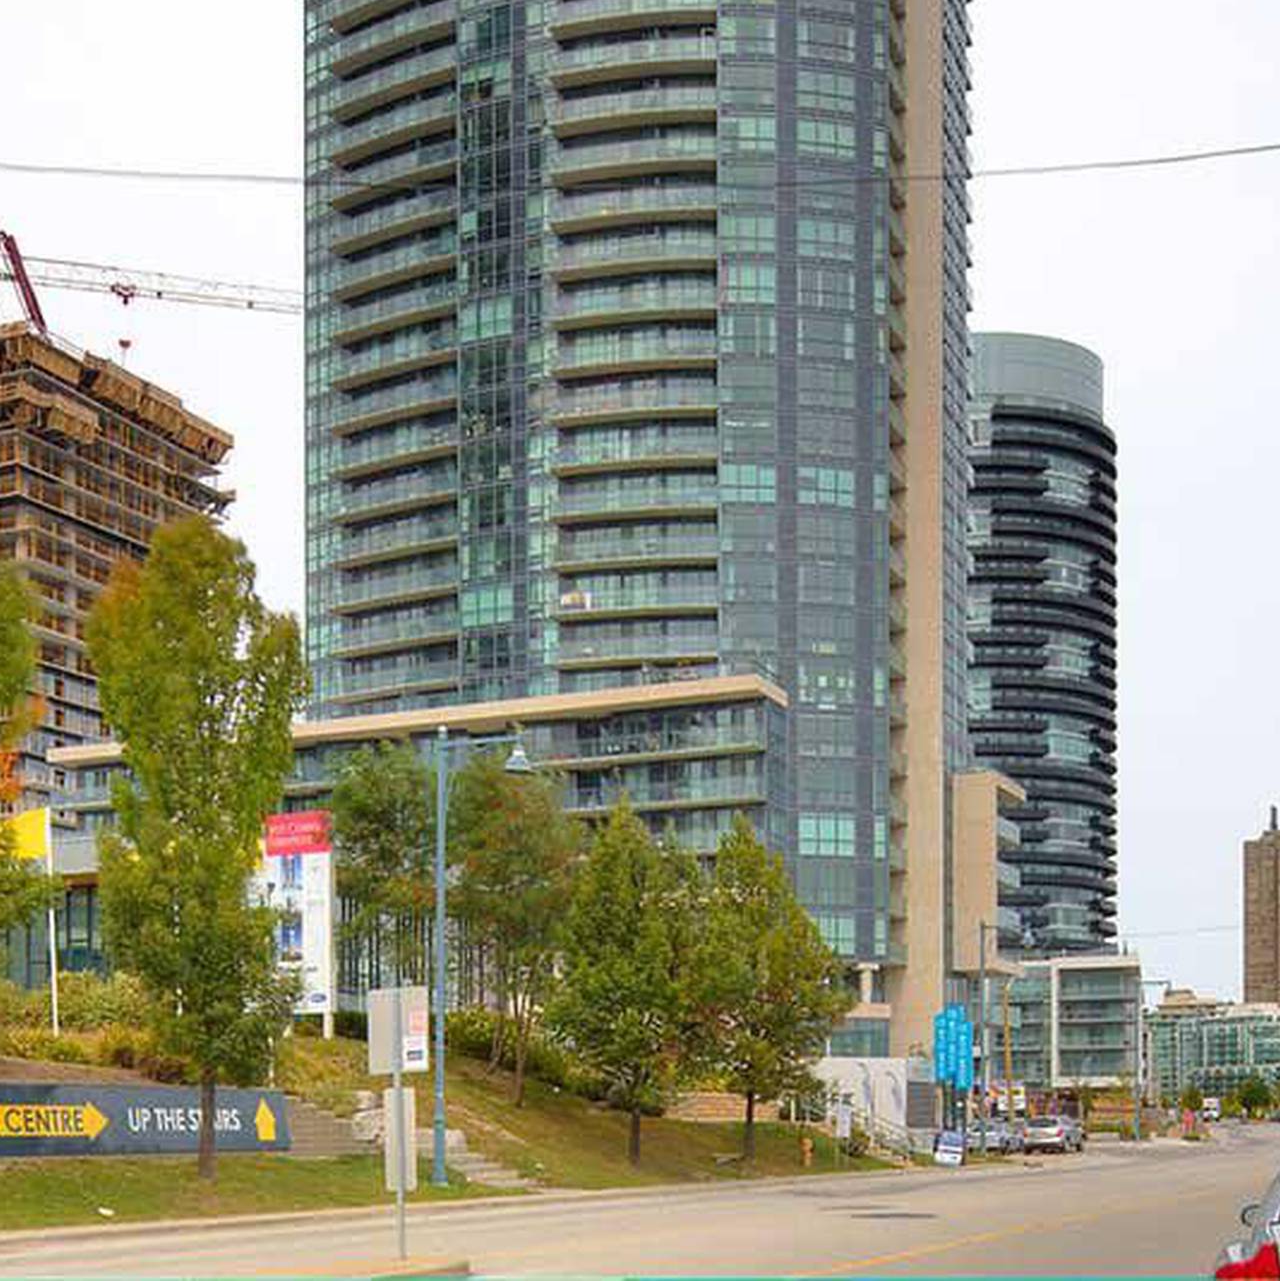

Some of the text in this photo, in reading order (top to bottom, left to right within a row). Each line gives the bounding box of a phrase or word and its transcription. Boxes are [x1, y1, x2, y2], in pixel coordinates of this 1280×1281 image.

[4, 1108, 85, 1134] CENTRE
[127, 1107, 242, 1132] UP THE SIRS
